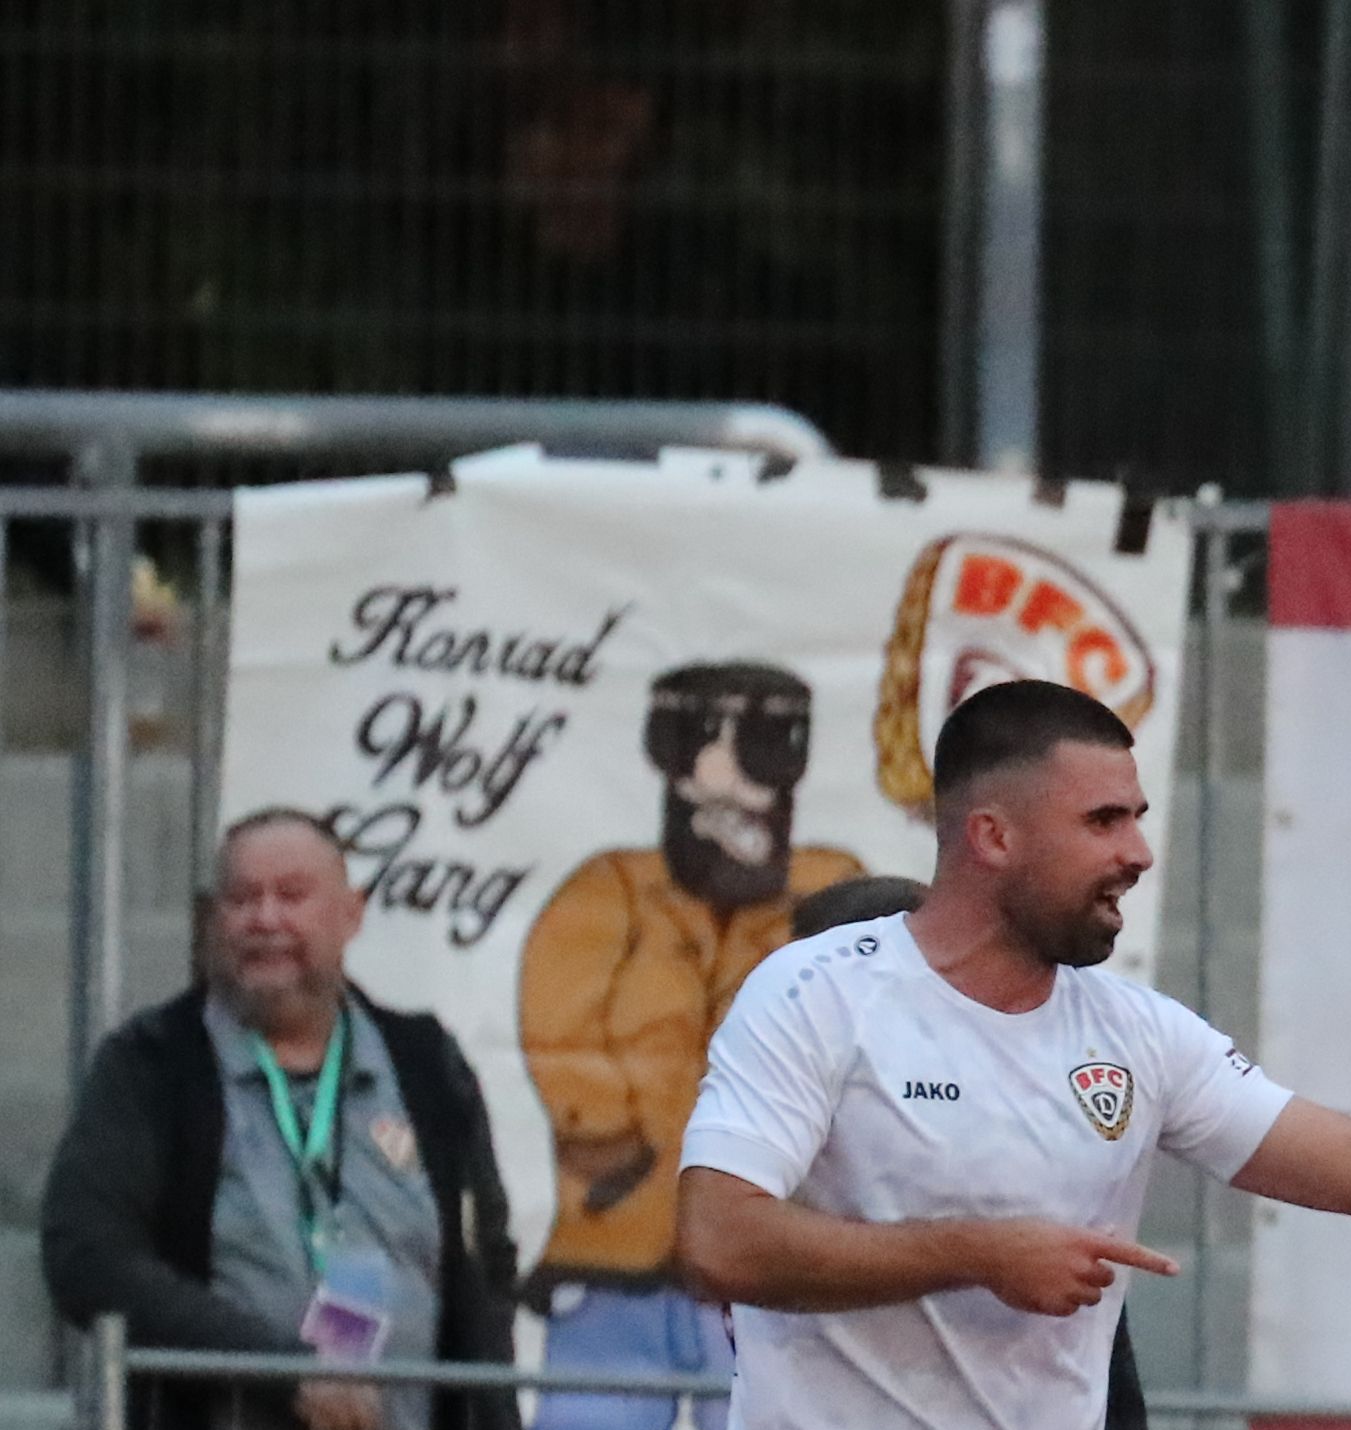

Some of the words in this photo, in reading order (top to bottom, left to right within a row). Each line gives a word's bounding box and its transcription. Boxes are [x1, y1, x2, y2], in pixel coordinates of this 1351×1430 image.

[329, 583, 640, 687] Konrad
[953, 554, 1129, 699] BFC
[357, 694, 566, 830] Wolf
[322, 804, 540, 948] Gang
[903, 1081, 960, 1101] JAKO
[1075, 1068, 1123, 1091] BFC
